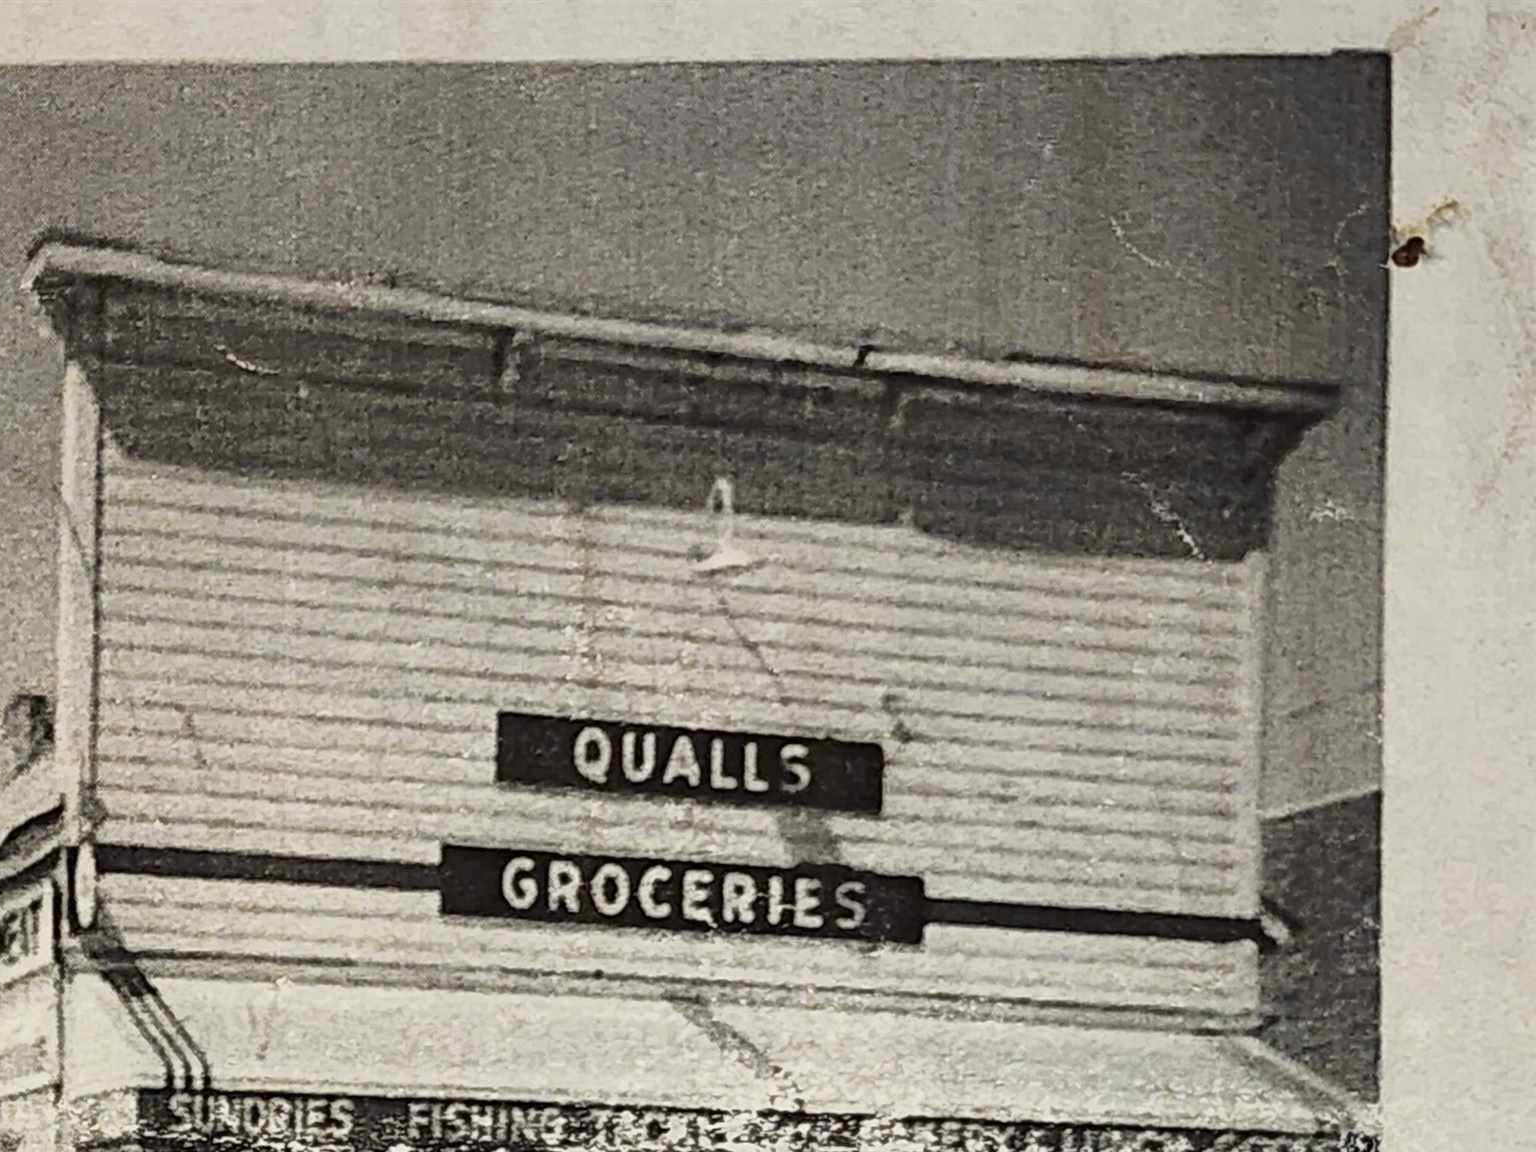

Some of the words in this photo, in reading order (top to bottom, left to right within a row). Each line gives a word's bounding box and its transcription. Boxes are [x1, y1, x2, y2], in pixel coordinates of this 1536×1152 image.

[573, 725, 813, 794] QUALLS
[500, 856, 867, 929] GROCERIES
[168, 1093, 355, 1139] SUNDRIES
[407, 1101, 563, 1145] FISHING
